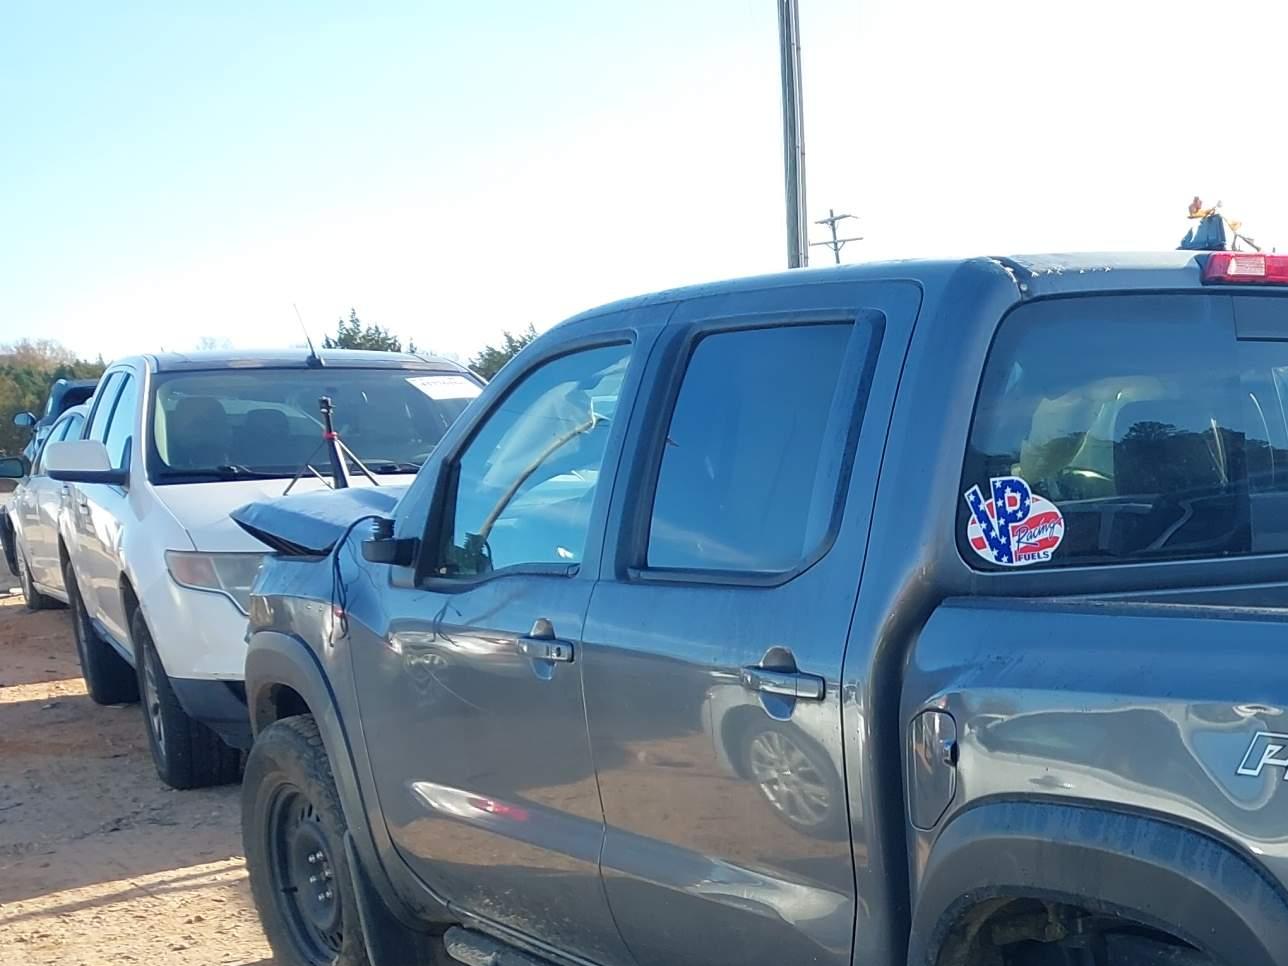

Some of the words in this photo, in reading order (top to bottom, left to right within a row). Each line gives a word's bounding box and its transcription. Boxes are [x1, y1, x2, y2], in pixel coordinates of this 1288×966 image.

[964, 476, 1032, 564] VP
[1016, 517, 1063, 549] Racing
[1018, 552, 1050, 562] FUELS
